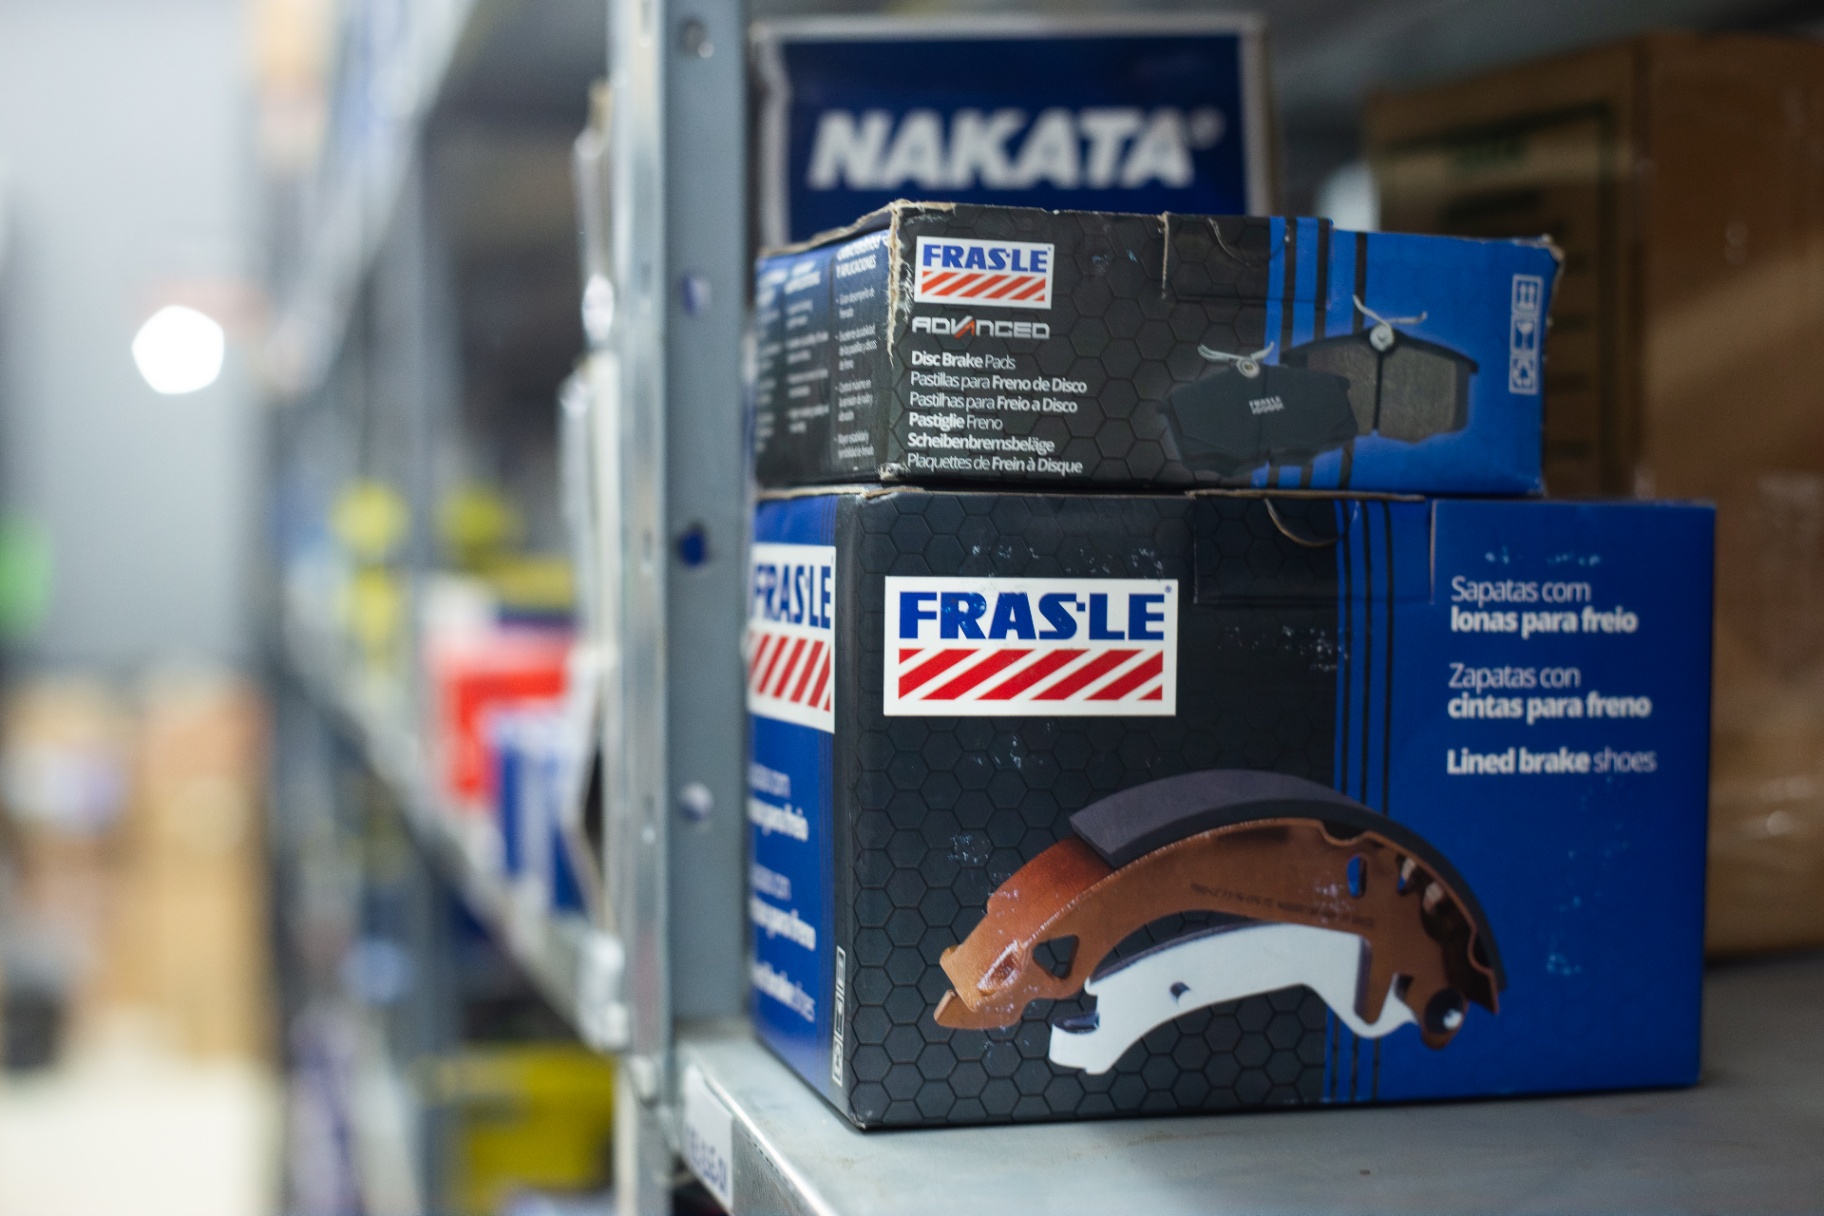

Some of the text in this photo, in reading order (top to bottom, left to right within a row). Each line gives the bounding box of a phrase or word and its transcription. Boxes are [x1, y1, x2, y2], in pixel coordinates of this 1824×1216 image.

[808, 107, 1194, 190] NAKATA
[912, 315, 1050, 339] ADVANCED
[911, 350, 1016, 370] Disc Brake Pads
[910, 371, 1088, 393] Pastillas para Freno de Disco
[910, 391, 1078, 413] Pastilhas para Freio a Disco
[909, 412, 1003, 431] Pastiglie Freno
[907, 432, 1055, 454] Scheibenbremsbeläge
[907, 453, 1083, 476] Plaquettes de Frein à Disque
[1450, 575, 1591, 608] Sapatas com
[1451, 605, 1639, 640] lonas para freio
[1449, 662, 1581, 694] Zapatas con
[1448, 691, 1652, 726] cintas para freno
[1447, 746, 1657, 774] Lined brake shoes
